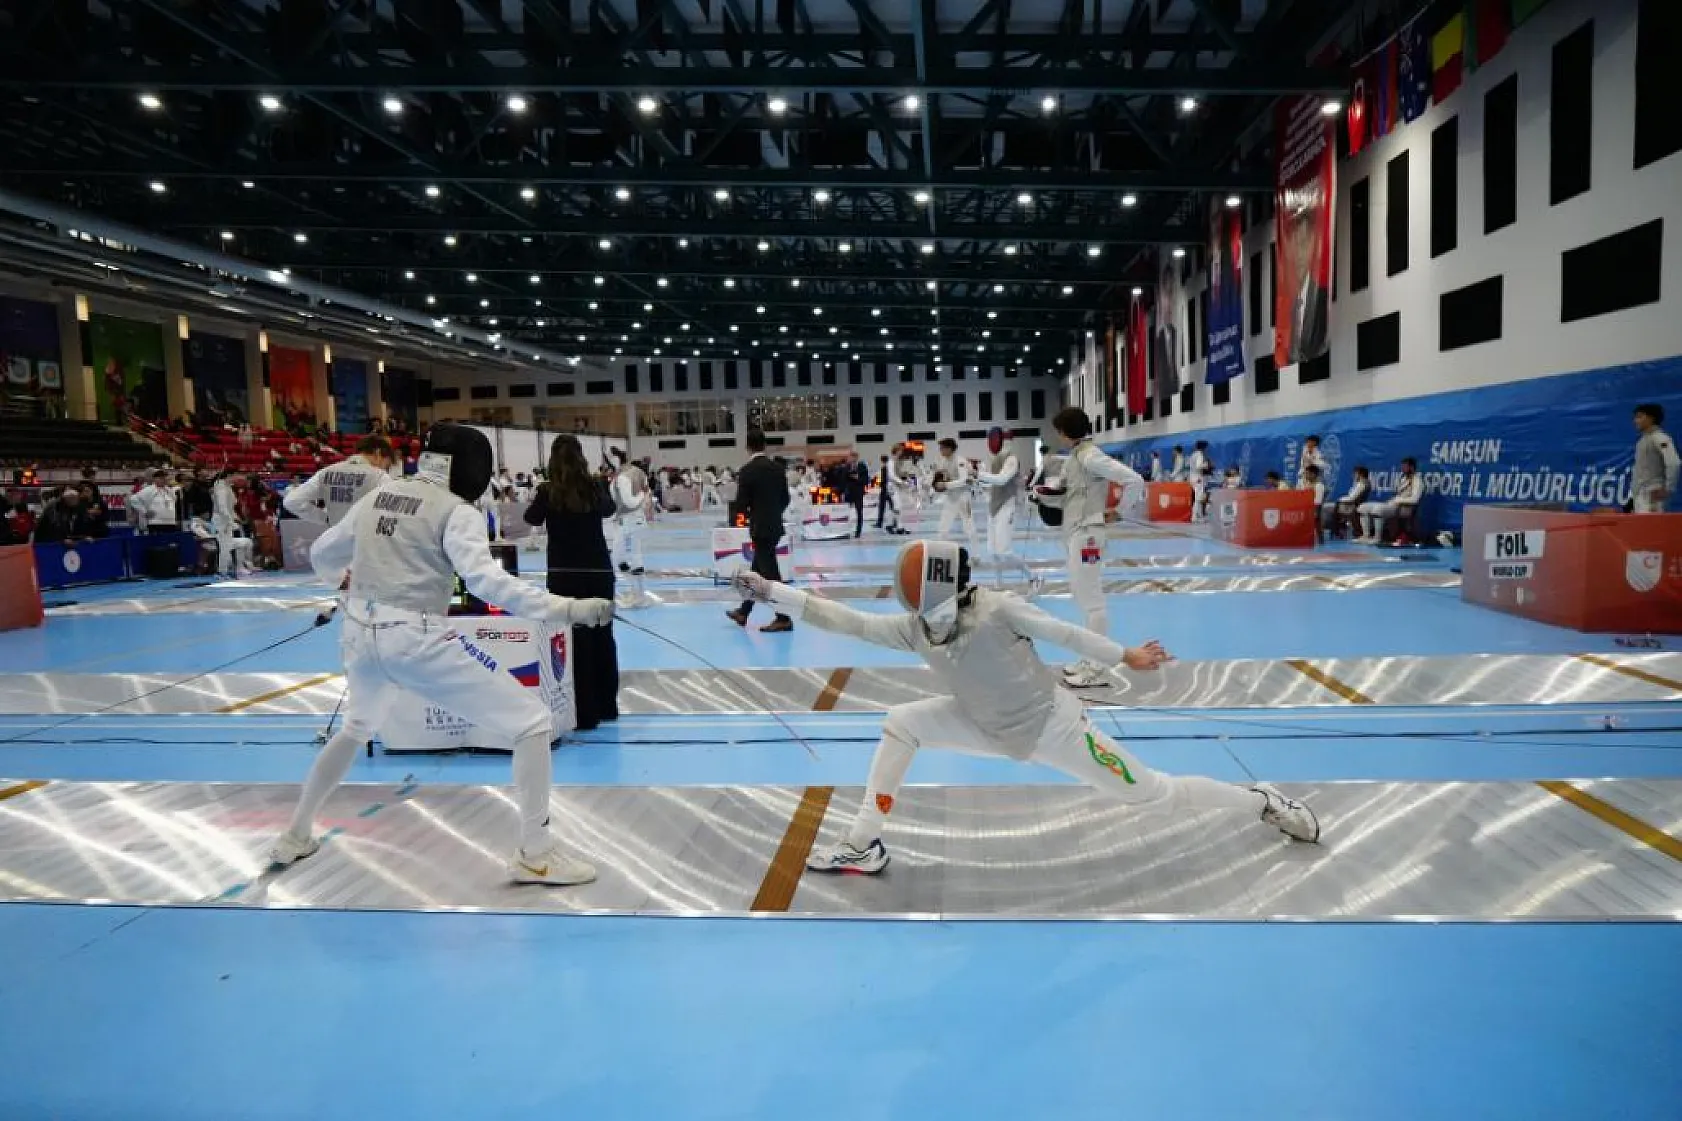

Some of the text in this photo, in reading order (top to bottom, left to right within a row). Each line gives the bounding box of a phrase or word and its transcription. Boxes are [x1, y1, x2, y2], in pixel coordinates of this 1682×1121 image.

[1430, 438, 1502, 465] SAMSUN
[329, 486, 354, 503] RUS
[1424, 471, 1464, 496] SPOR
[1468, 466, 1482, 498] İL
[1485, 463, 1633, 506] MÜDÜRLÜĞÜ
[373, 491, 424, 516] KHAMITOV
[375, 515, 398, 537] RUS
[1496, 531, 1529, 557] FOIL
[926, 556, 954, 583] IRL
